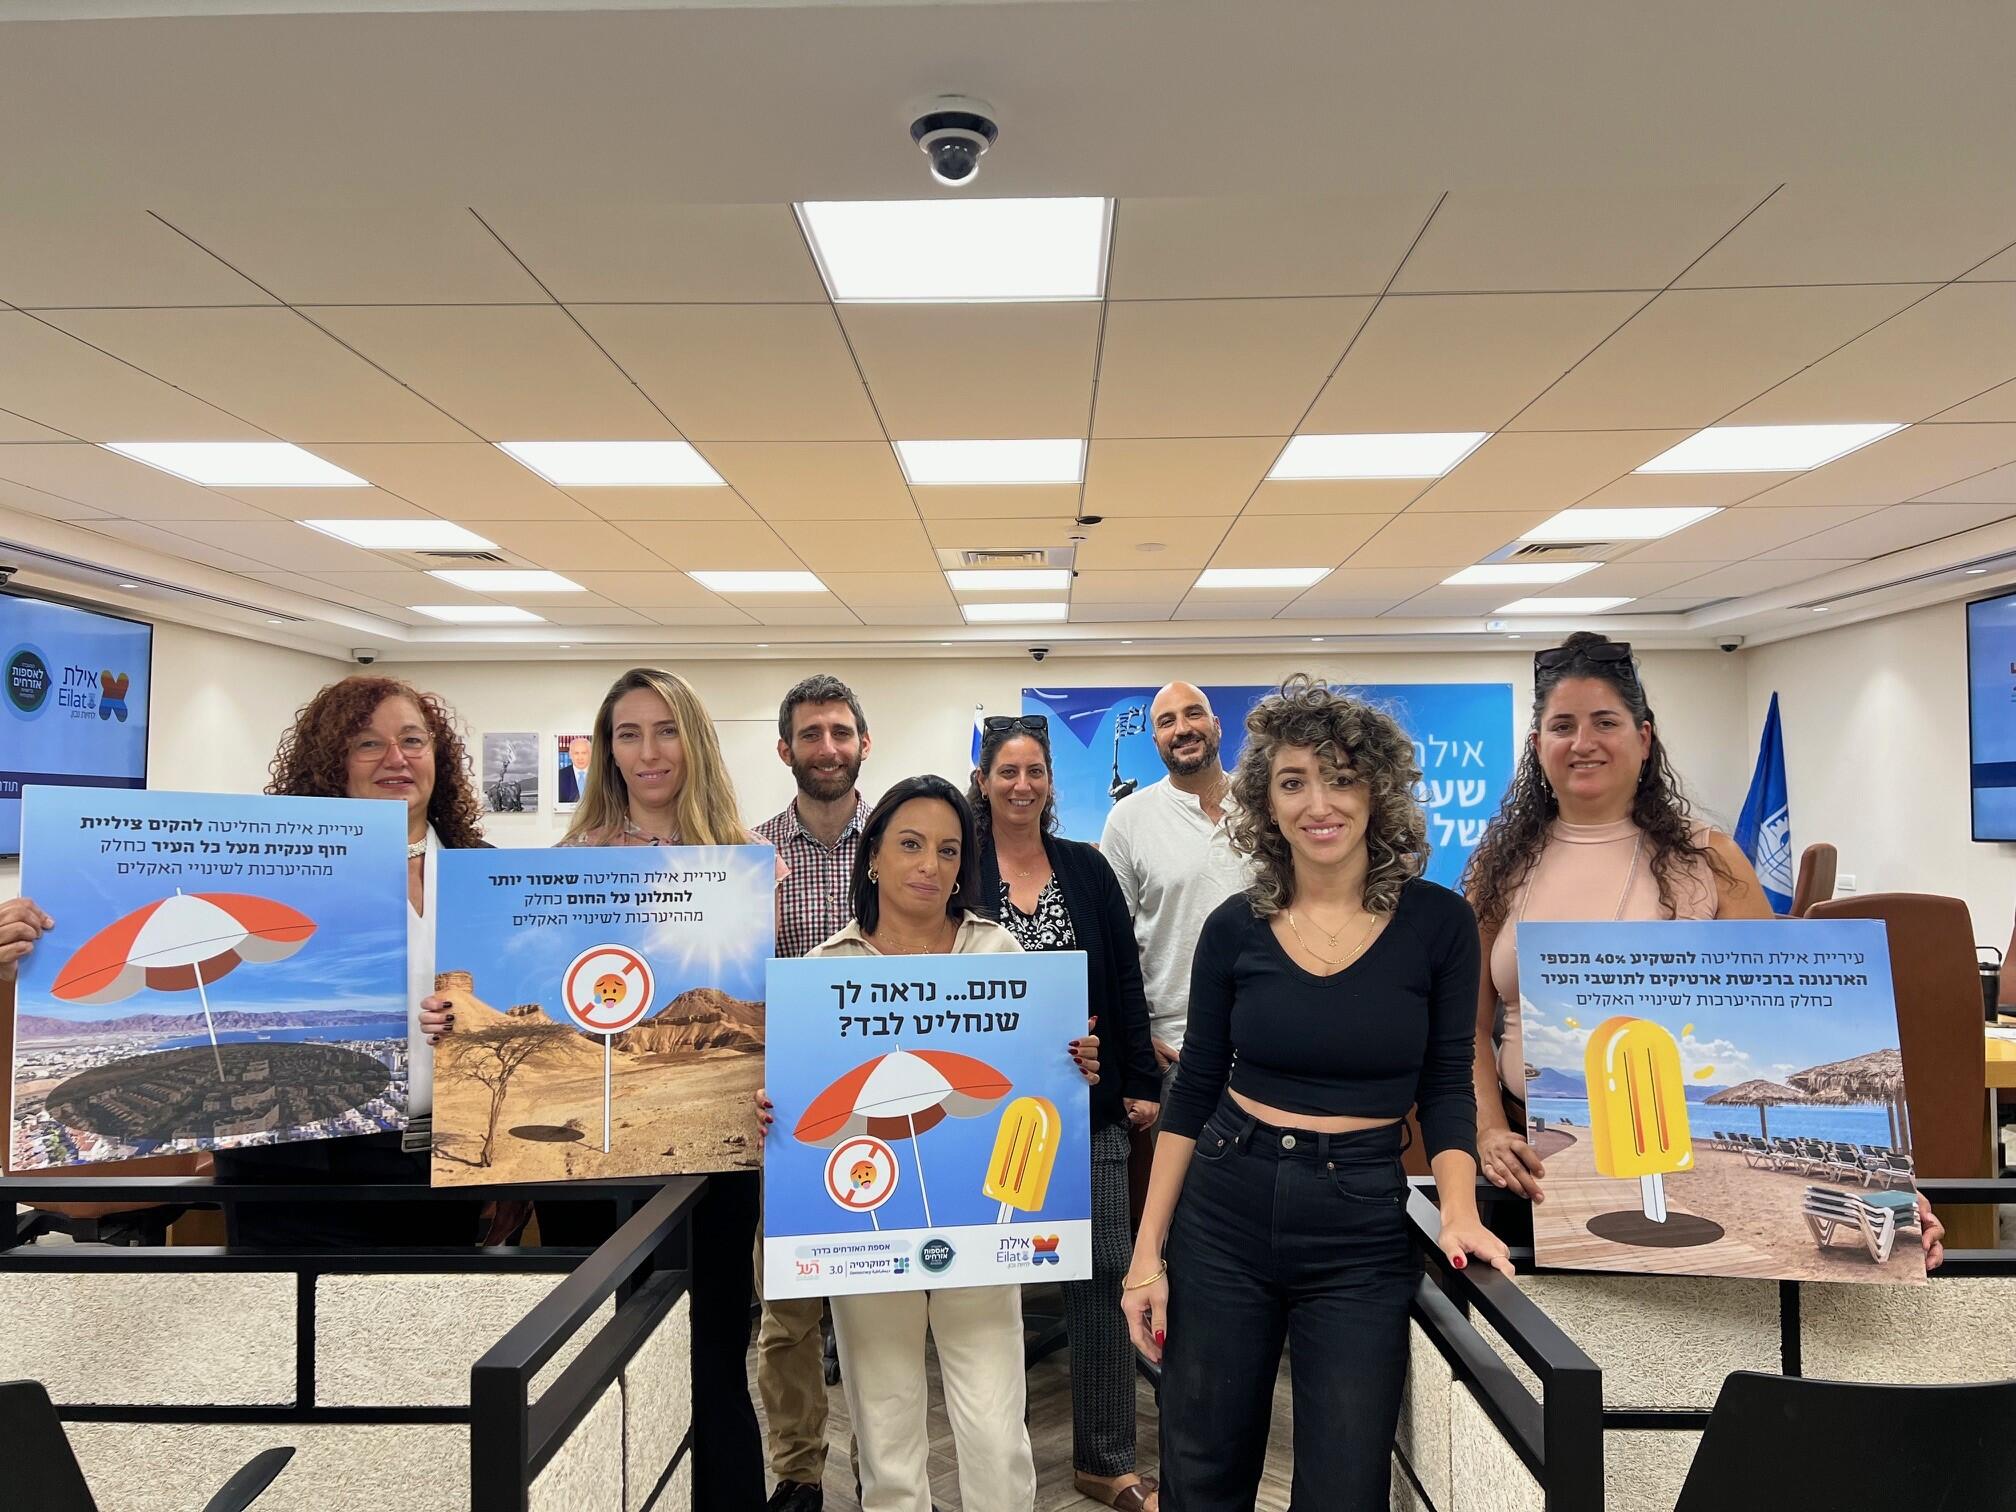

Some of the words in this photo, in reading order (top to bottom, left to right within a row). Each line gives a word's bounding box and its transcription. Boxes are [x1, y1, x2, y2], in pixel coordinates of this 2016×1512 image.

[12, 667, 44, 680] לאספות
[62, 665, 98, 689] אילת
[13, 677, 42, 690] אזרחים
[58, 688, 87, 709] Eilat
[80, 816, 142, 830] ציליית
[149, 817, 202, 833] להקים
[209, 819, 271, 834] החליטה
[276, 820, 312, 835] אילת
[318, 823, 364, 836] עיריית
[1432, 813, 1489, 847] של
[101, 837, 145, 854] כחלק
[152, 841, 194, 853] העיר
[201, 840, 221, 854] כל
[227, 841, 259, 855] מעל
[265, 844, 313, 856] ענקית
[319, 845, 347, 857] חוף
[118, 860, 181, 876] האקלים
[189, 861, 242, 876] לשינויי
[248, 863, 333, 876] מההיערכות
[488, 875, 522, 887] יותר
[527, 873, 579, 886] שאסור
[583, 872, 639, 885] החליטה
[644, 871, 678, 885] אילת
[683, 871, 727, 883] עיריית
[524, 893, 562, 907] כחלק
[567, 893, 605, 905] החום
[611, 891, 629, 904] על
[636, 891, 692, 906] להתלונן
[513, 912, 568, 927] האקלים
[574, 911, 620, 925] לשינויי
[625, 911, 703, 925] מההיערכות
[1541, 953, 1590, 965] מכספי
[1595, 953, 1626, 965] 40%
[1631, 951, 1696, 966] להשקיע
[1701, 950, 1764, 965] החליטה
[1769, 951, 1809, 965] אילת
[1814, 952, 1865, 966] עיריית
[1541, 973, 1579, 985] העיר
[1585, 971, 1645, 985] לתושבי
[1651, 973, 1721, 988] ארטיקים
[1726, 973, 1794, 986] ברכישת
[1799, 973, 1868, 986] הארנונה
[831, 980, 862, 1010] לך
[871, 981, 936, 1003] נראה
[946, 980, 1027, 1000] סתם...
[1577, 992, 1634, 1008] האקלים
[1639, 992, 1691, 1007] לשינויי
[1697, 993, 1785, 1007] מההיערכות
[1790, 992, 1833, 1009] כחלק
[838, 1012, 904, 1037] לבד?
[913, 1010, 1020, 1034] שנחליט
[1000, 1236, 1030, 1250] אילת
[996, 1250, 1021, 1262] Eilat
[829, 1265, 844, 1275] 3.0
[849, 1259, 891, 1270] דמוקרטיה
